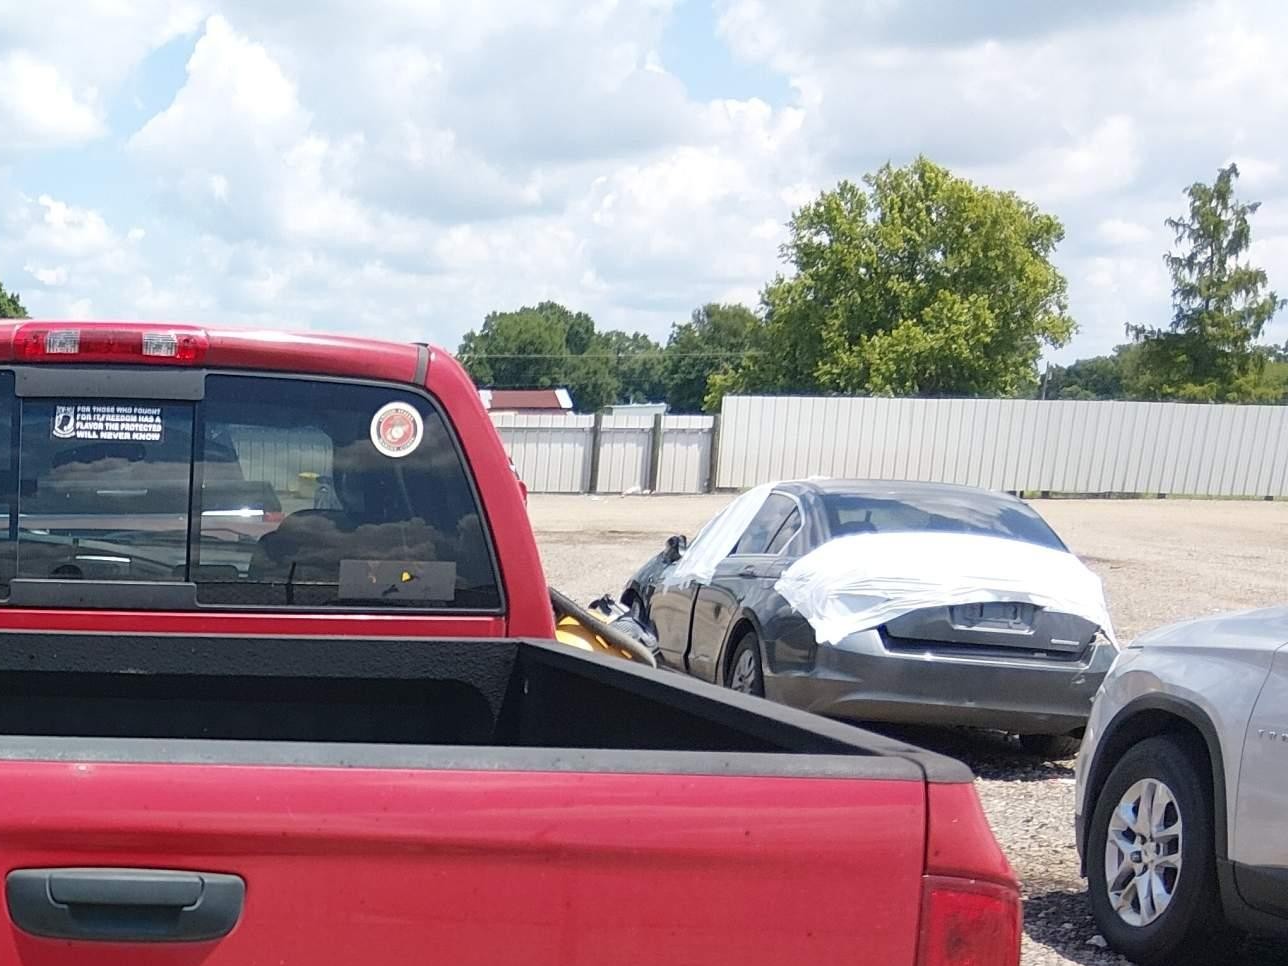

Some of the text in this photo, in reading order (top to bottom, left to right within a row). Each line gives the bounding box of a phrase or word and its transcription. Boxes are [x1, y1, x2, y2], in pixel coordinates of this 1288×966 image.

[76, 405, 91, 413] FOR
[116, 406, 133, 414] WHO
[76, 413, 91, 421] FOR
[76, 421, 162, 432] FLAVOR THE PROTECTED
[76, 430, 161, 441] WILL NEVER KNOW
